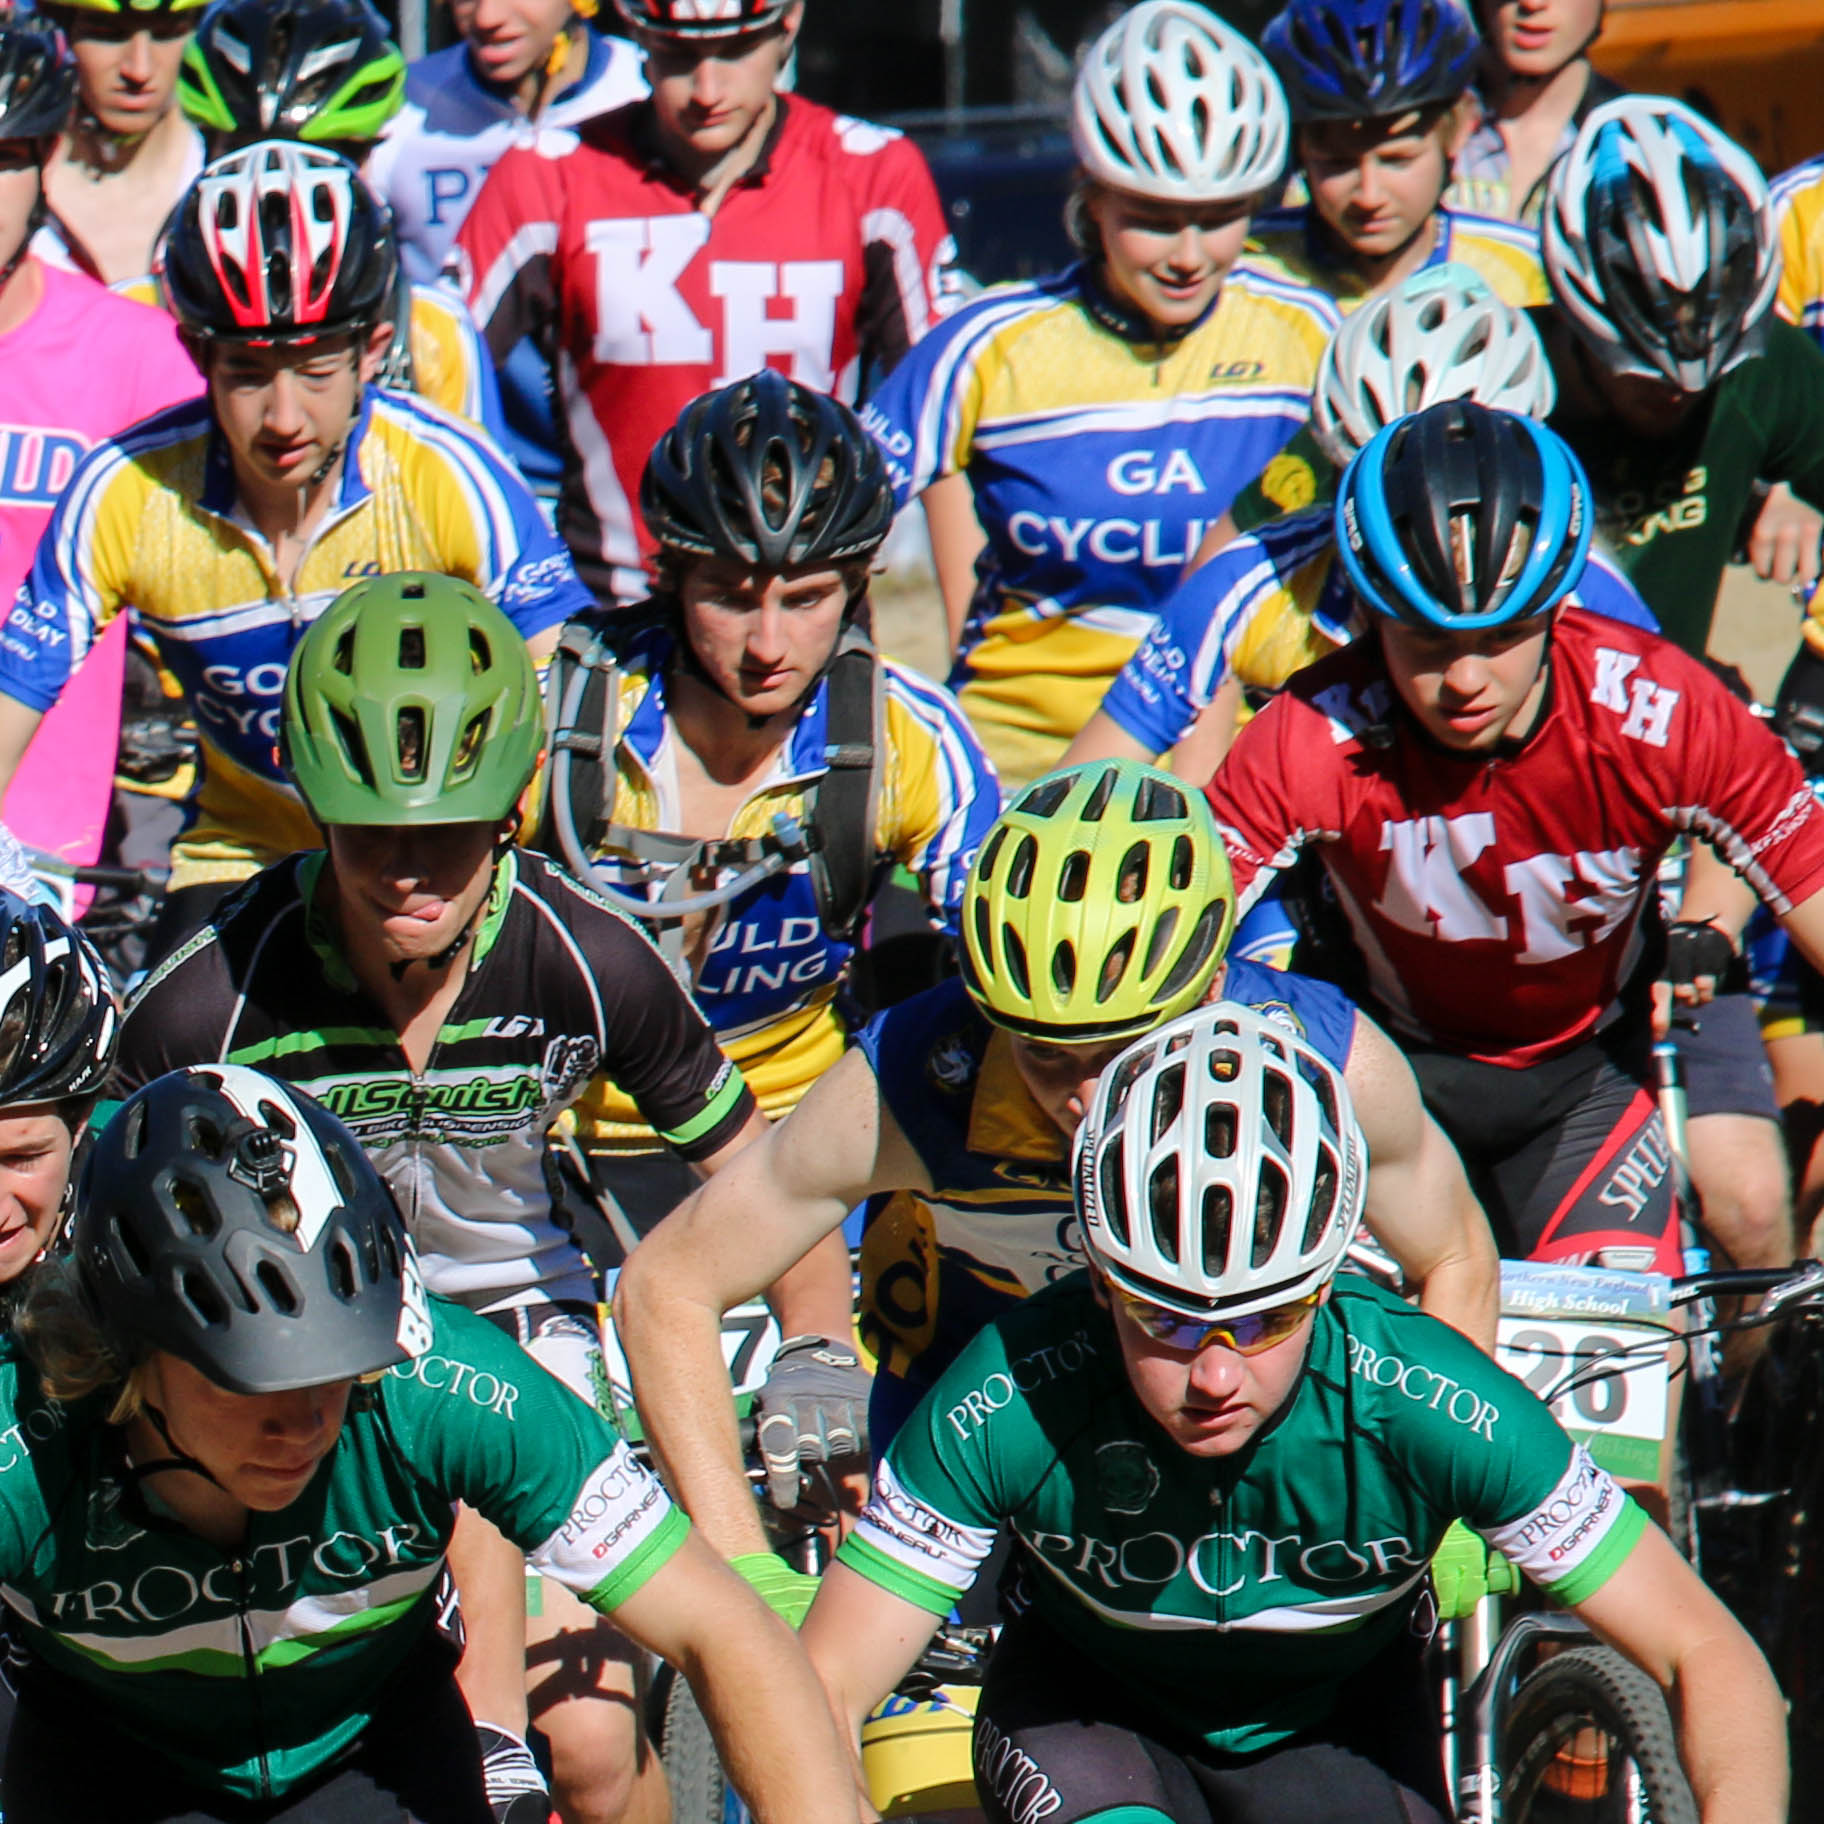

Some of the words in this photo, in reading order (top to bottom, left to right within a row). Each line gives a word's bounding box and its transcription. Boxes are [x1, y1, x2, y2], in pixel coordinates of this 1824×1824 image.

[585, 212, 843, 390] KH
[1104, 448, 1205, 494] GA
[1592, 656, 1680, 748] KH
[1564, 1293, 1631, 1316] School
[1027, 1526, 1428, 1600] PROCTOR
